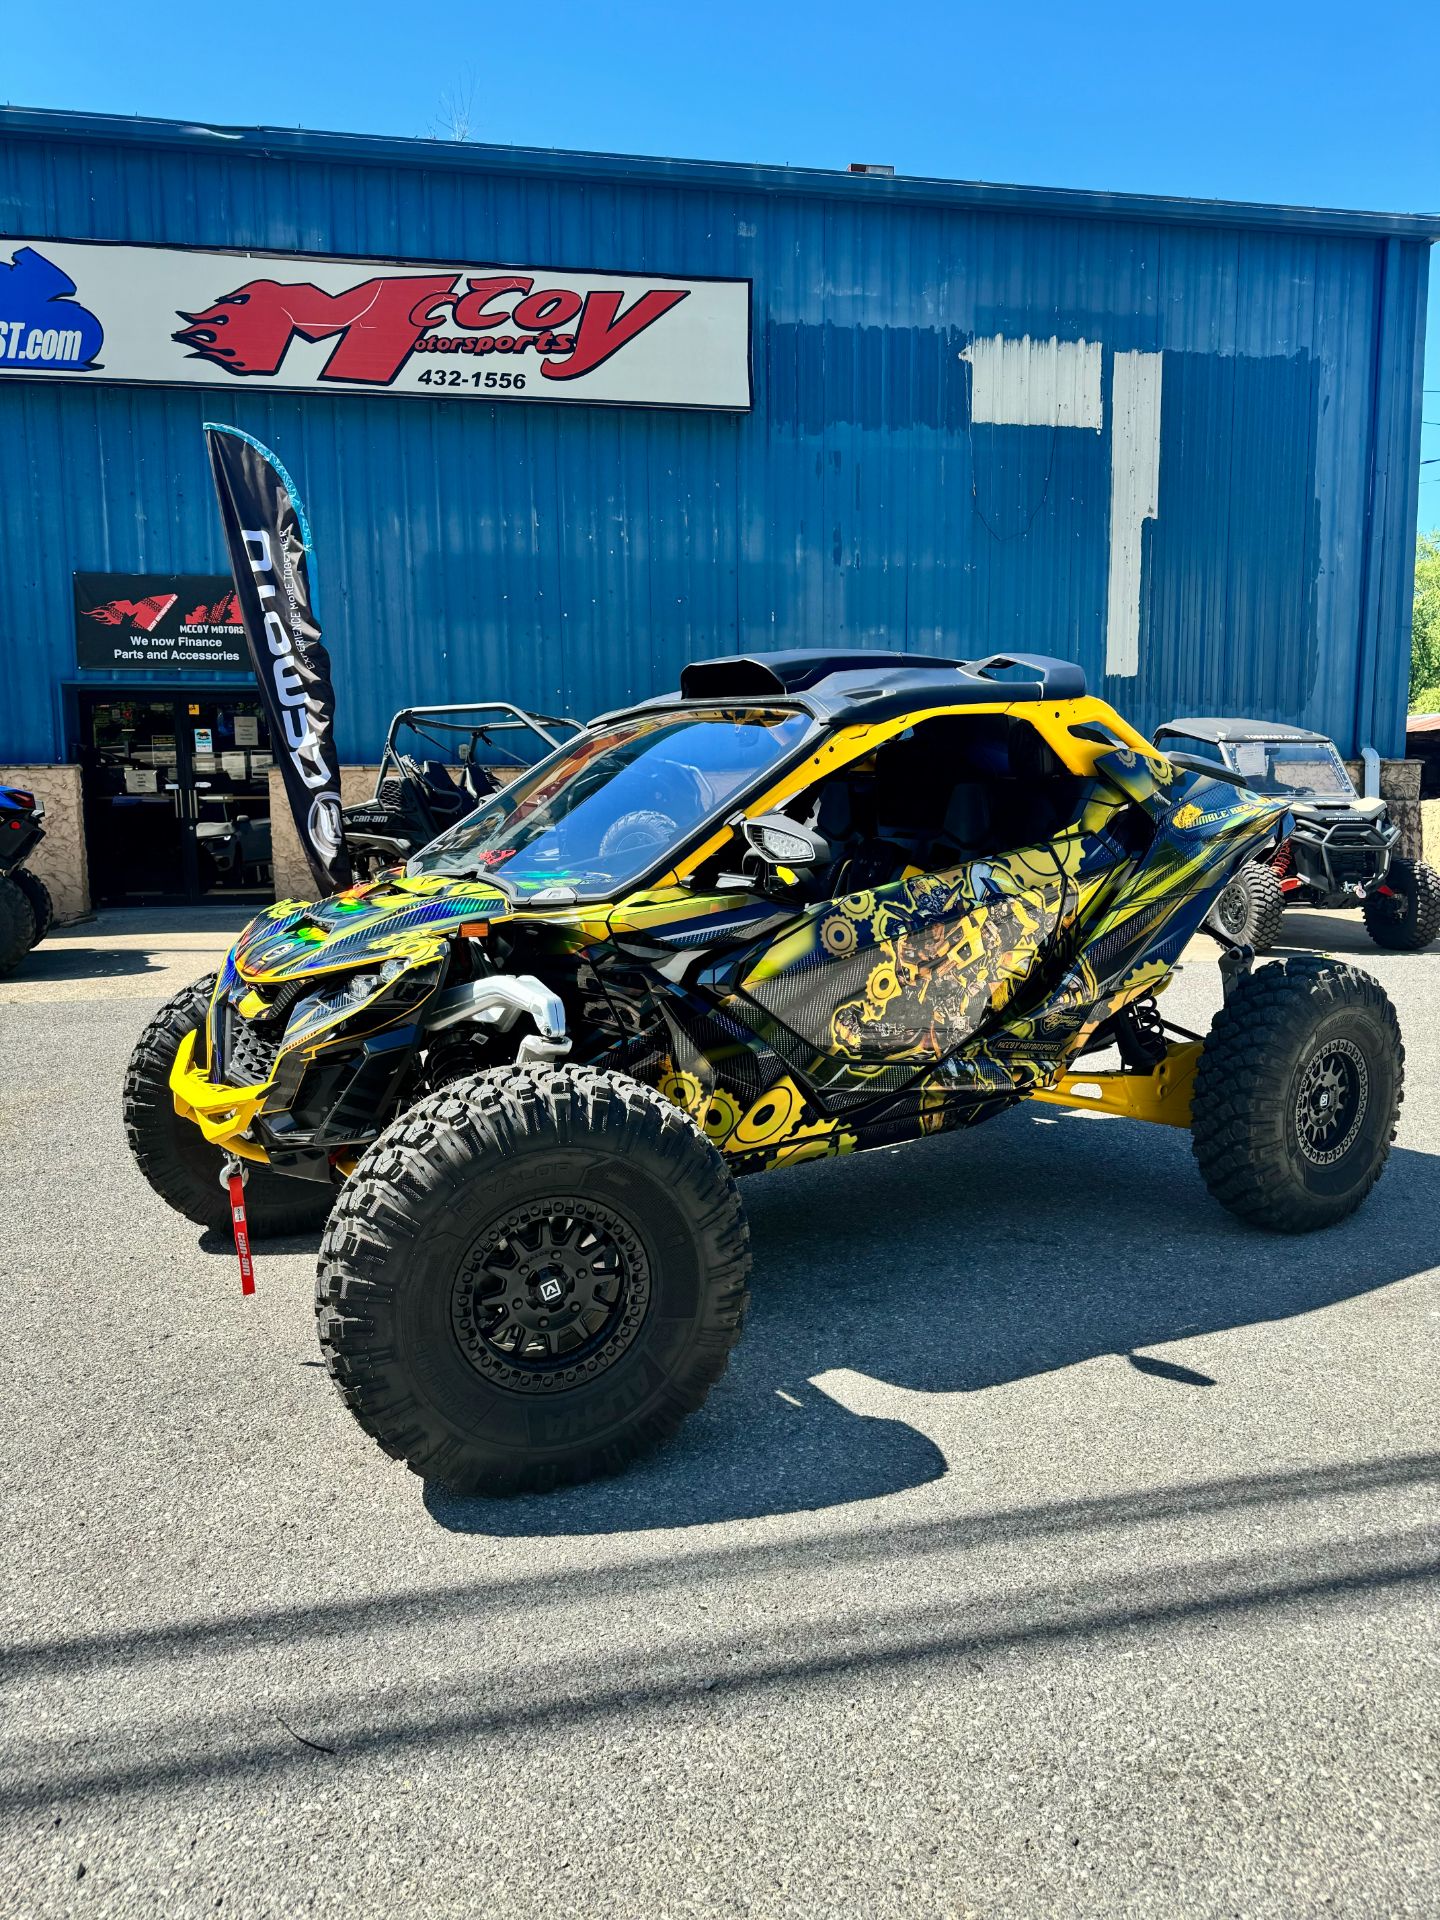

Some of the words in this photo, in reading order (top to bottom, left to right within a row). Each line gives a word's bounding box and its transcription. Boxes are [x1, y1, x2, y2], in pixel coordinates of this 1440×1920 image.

[418, 369, 527, 390] 432-1556
[278, 530, 293, 580] TOGETHER
[286, 581, 298, 610] MORE
[179, 625, 209, 634] MCCOY
[210, 625, 246, 635] MOTORS
[130, 636, 149, 646] We
[151, 638, 175, 646] now
[178, 637, 223, 647] Finance
[114, 649, 144, 659] Parts
[146, 650, 168, 660] and
[171, 650, 240, 661] Accessories
[352, 814, 389, 823] can-am
[997, 1041, 1020, 1049] MCCOY
[1019, 1042, 1061, 1052] MOTORSPORTS
[237, 1232, 251, 1276] can-am
